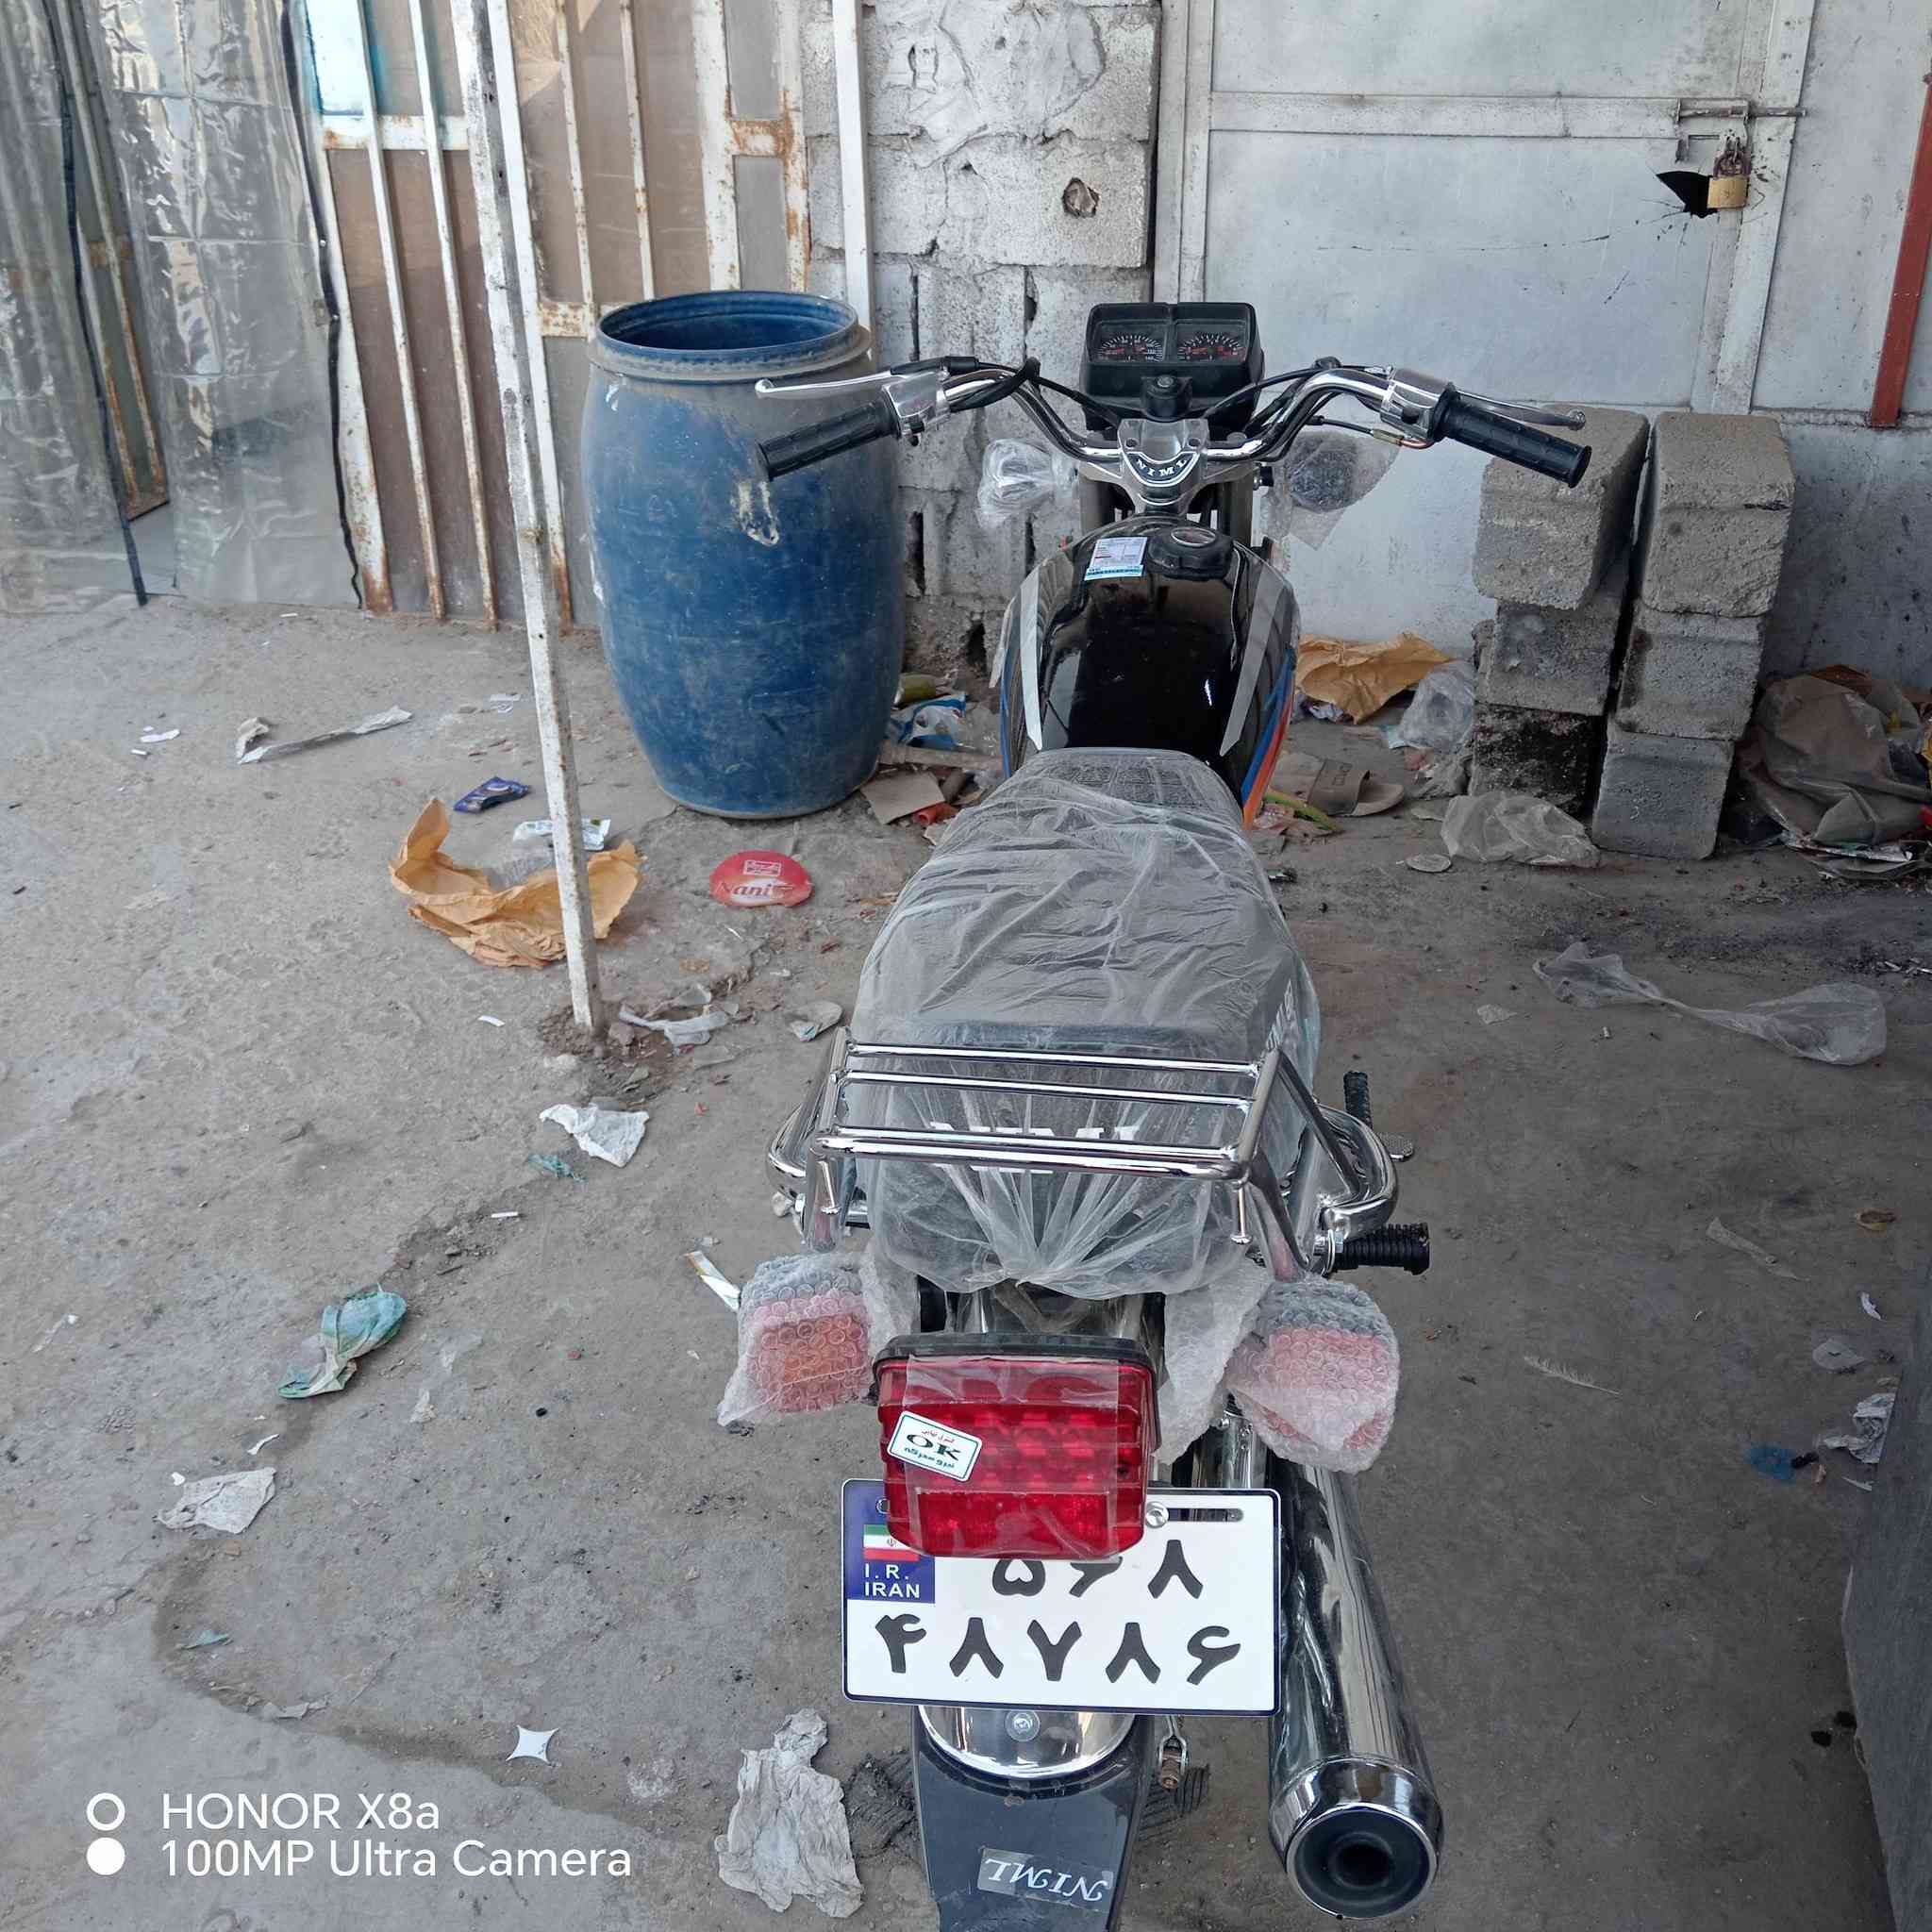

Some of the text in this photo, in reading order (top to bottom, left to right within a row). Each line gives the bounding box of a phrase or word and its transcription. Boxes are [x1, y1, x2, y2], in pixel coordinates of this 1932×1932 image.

[907, 1434, 961, 1461] OK
[864, 1581, 921, 1599] IRAN
[874, 1613, 1241, 1686] ۴۸۷۸۶
